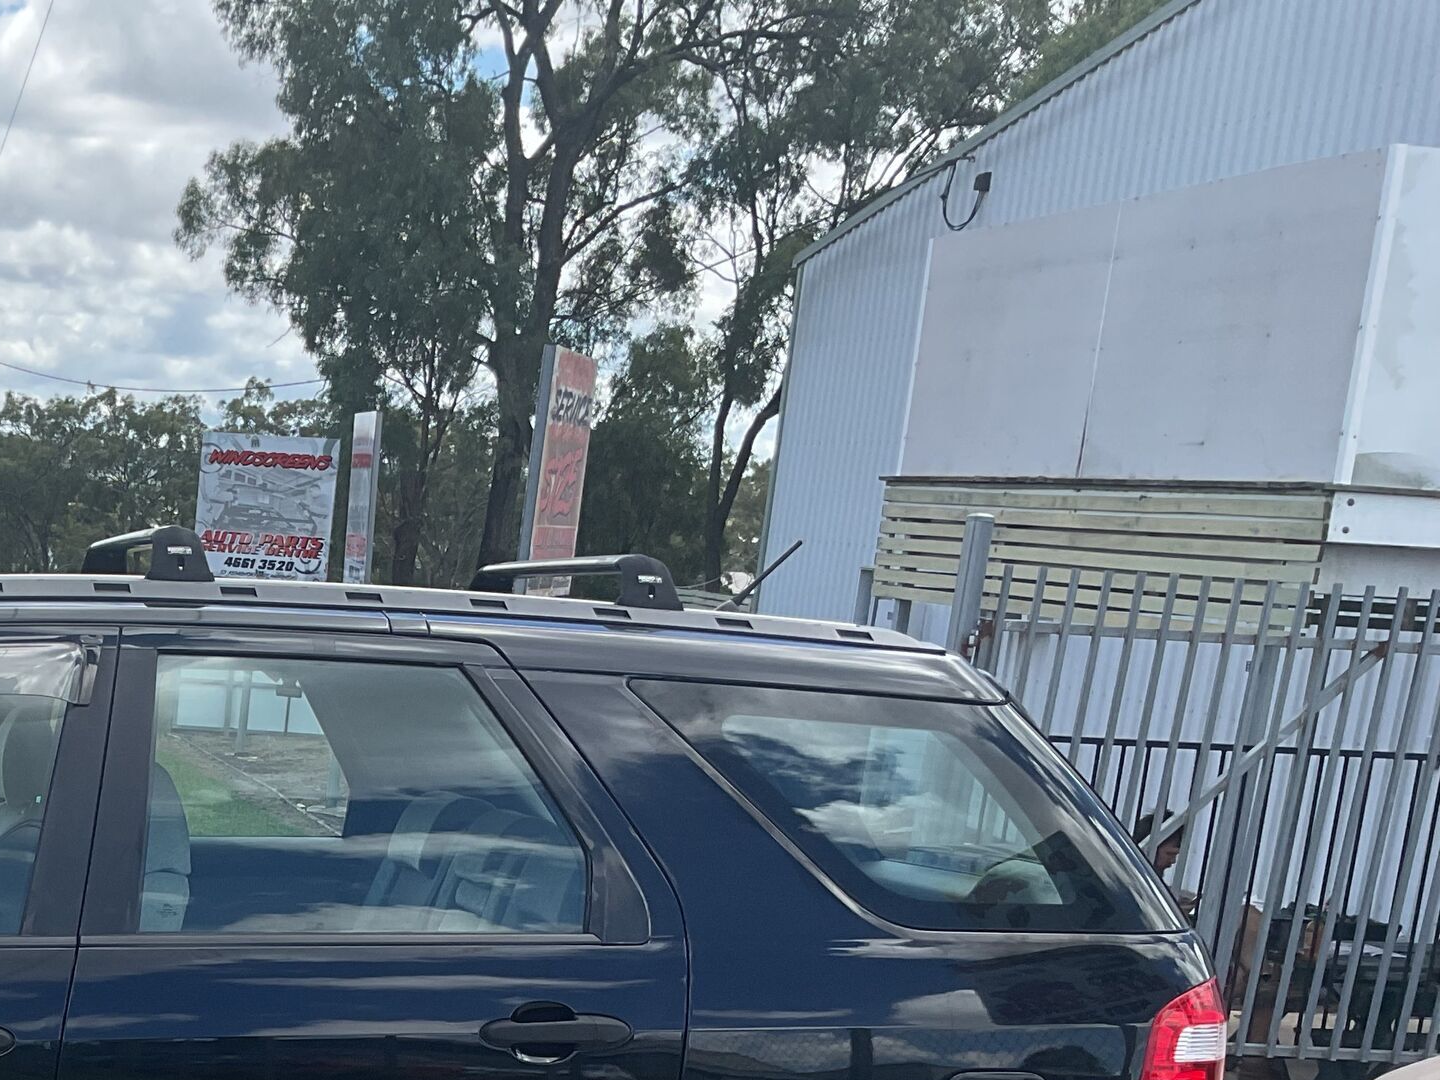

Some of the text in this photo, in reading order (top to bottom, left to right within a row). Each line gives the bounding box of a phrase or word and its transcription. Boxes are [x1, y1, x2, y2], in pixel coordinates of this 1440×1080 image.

[210, 449, 332, 470] WINDSCREENS
[201, 530, 325, 550] AUTO PARTS
[224, 557, 294, 571] 4661 3520
